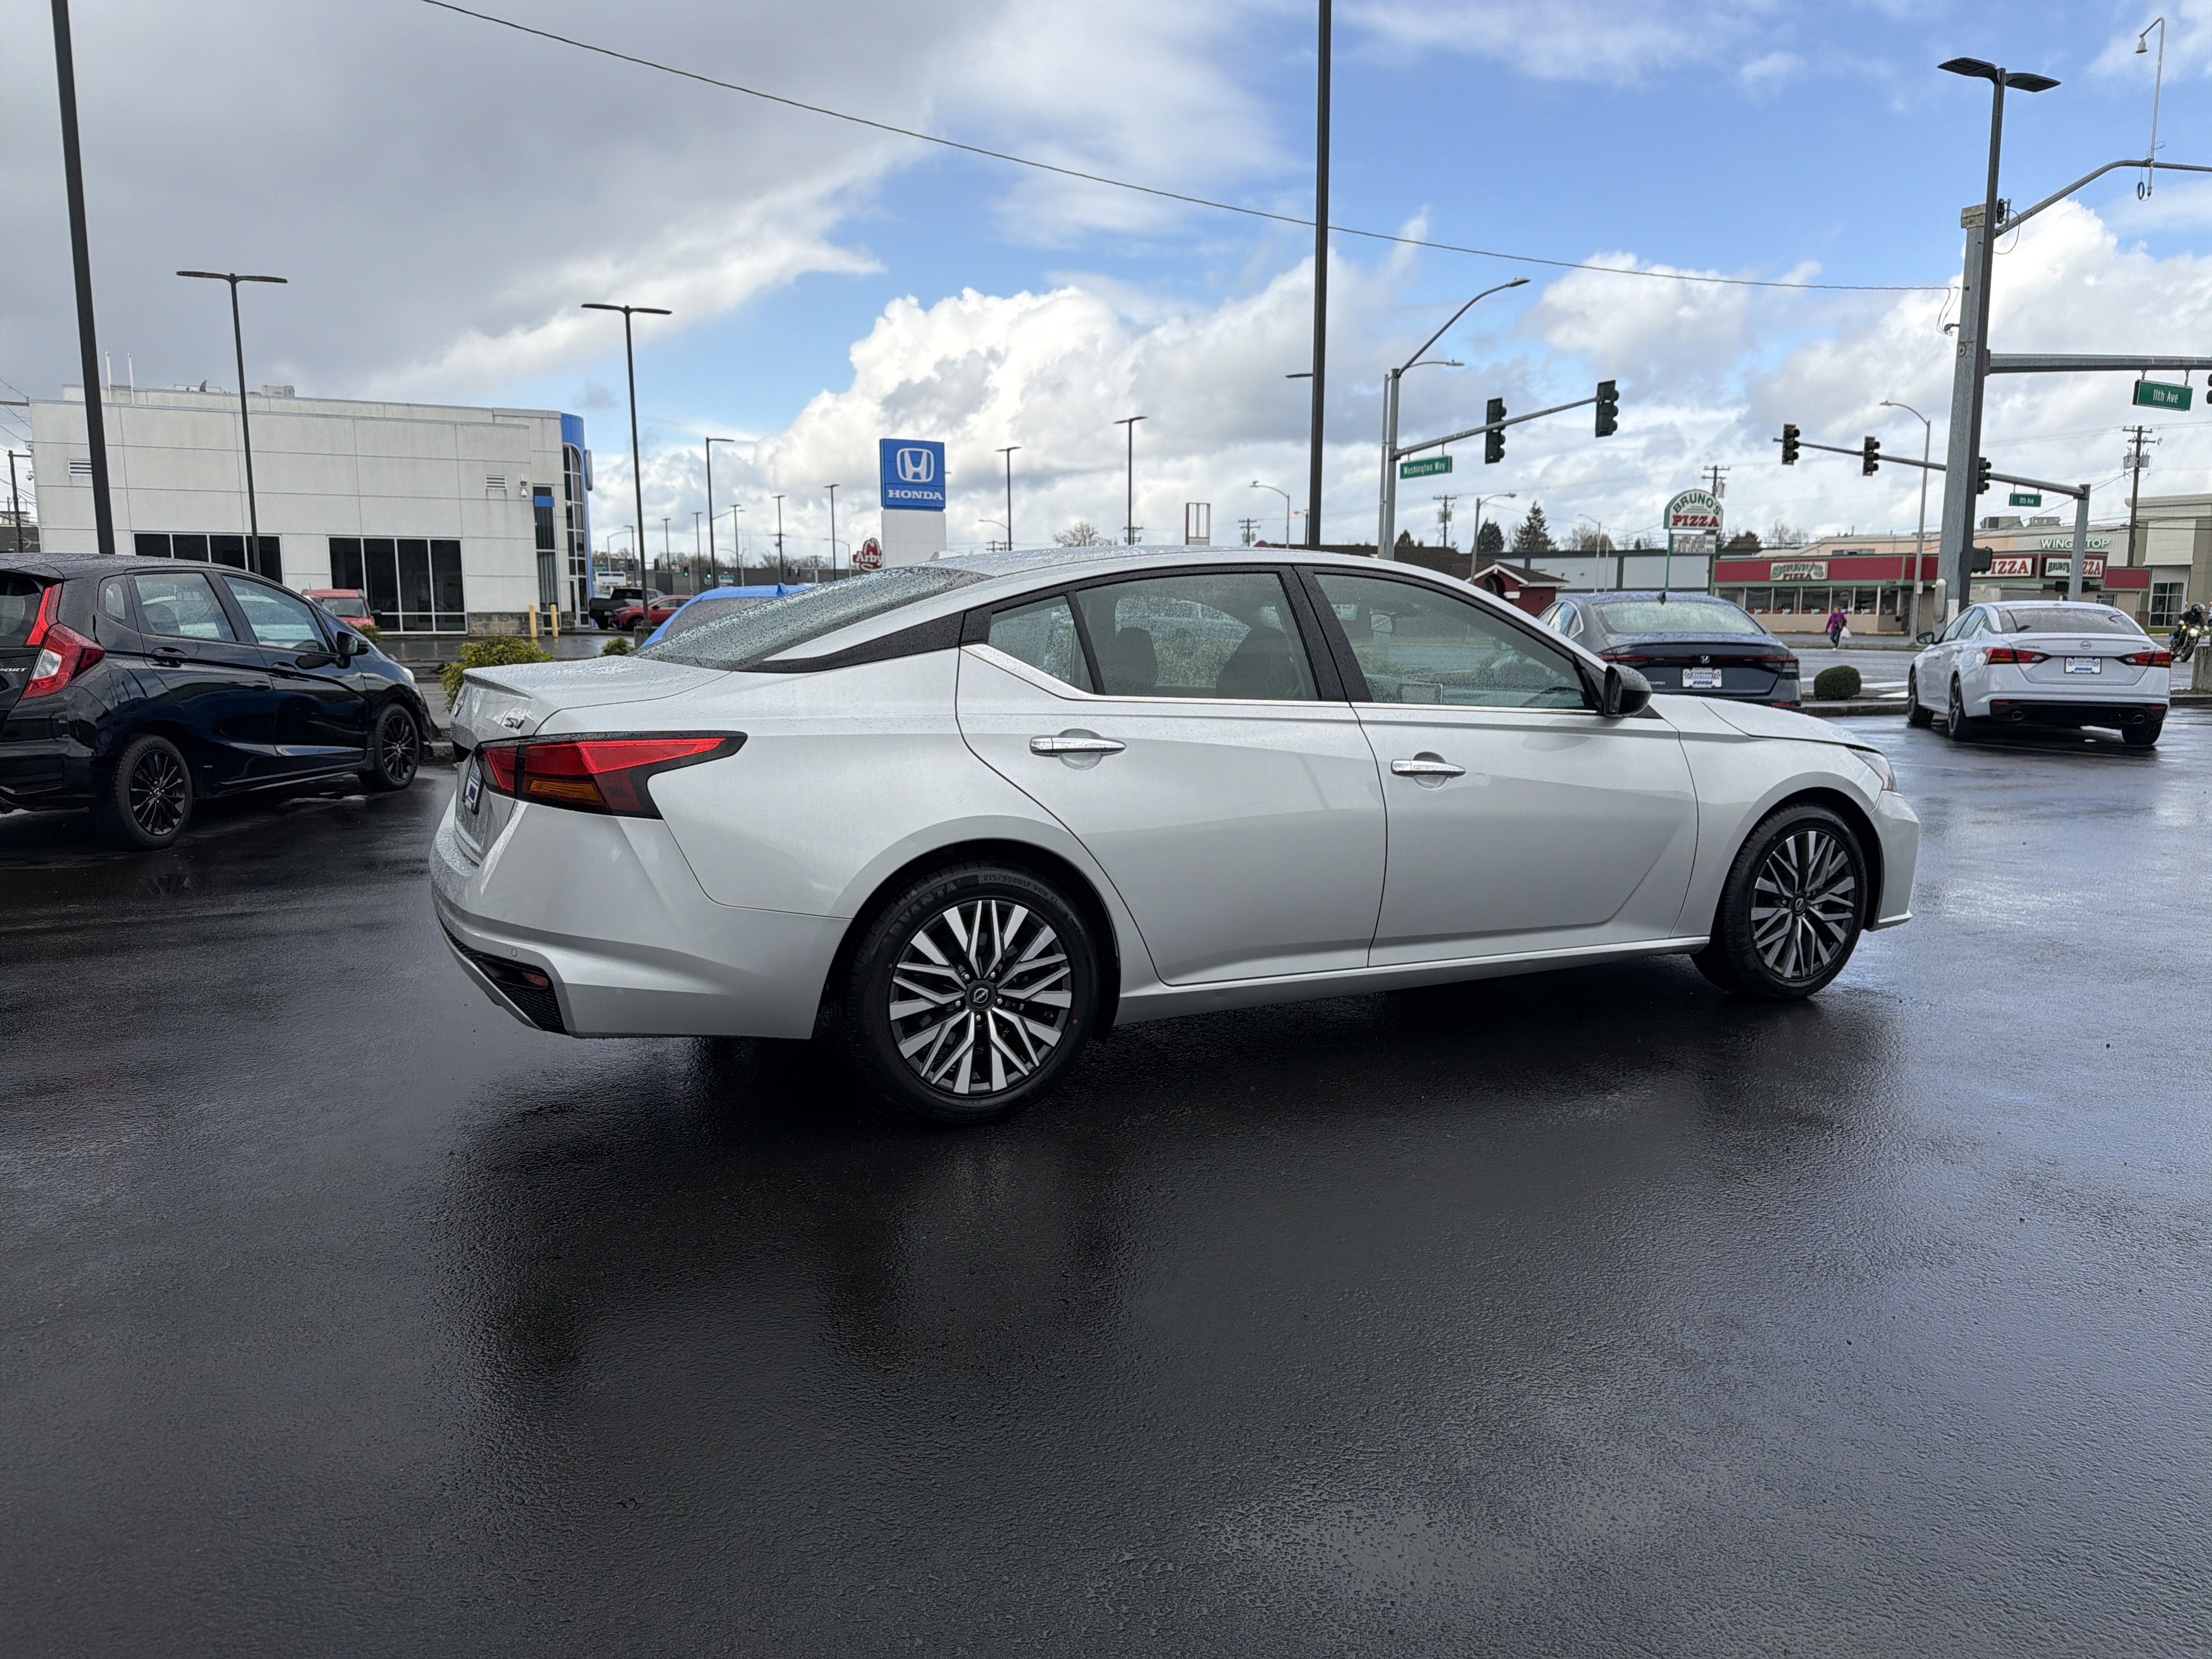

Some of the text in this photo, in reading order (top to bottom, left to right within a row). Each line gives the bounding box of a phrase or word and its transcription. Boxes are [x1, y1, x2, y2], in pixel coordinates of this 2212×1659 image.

[2153, 389, 2179, 404] 11th Ave
[1403, 461, 1446, 475] Washington Way
[888, 489, 944, 500] HONDA
[1673, 493, 1721, 515] BRUNO'S
[1672, 515, 1719, 527] PIZZA
[2041, 538, 2110, 549] WINGTOP
[1771, 562, 1824, 578] BRUNO'S
[1981, 560, 2029, 574] IZZA
[2047, 561, 2101, 575] BRUNO'S ZZA
[504, 716, 524, 730] SV
